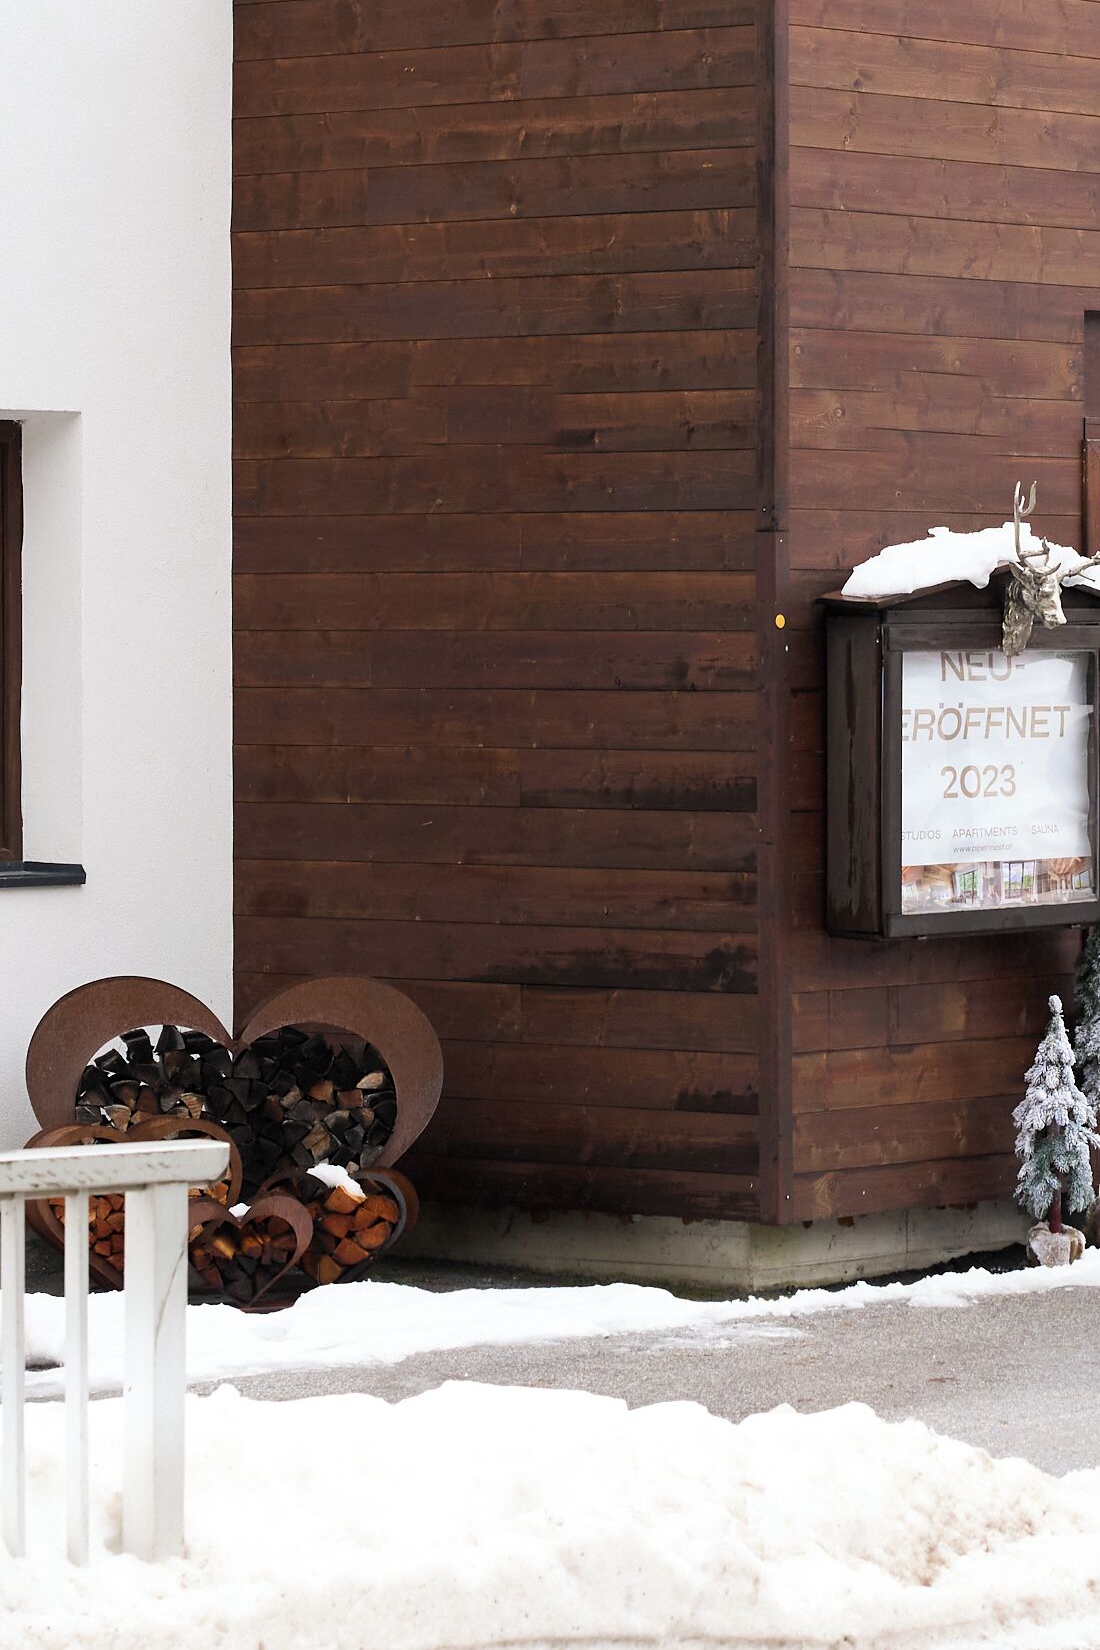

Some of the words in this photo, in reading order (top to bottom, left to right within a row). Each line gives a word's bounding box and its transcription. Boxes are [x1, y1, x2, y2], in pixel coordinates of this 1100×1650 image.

[901, 702, 1071, 741] ERÖFFNET
[940, 764, 1017, 799] 2023
[901, 829, 942, 841] STUDIOS
[952, 825, 1018, 839] APARTMENTS
[1031, 823, 1061, 836] SAUNA
